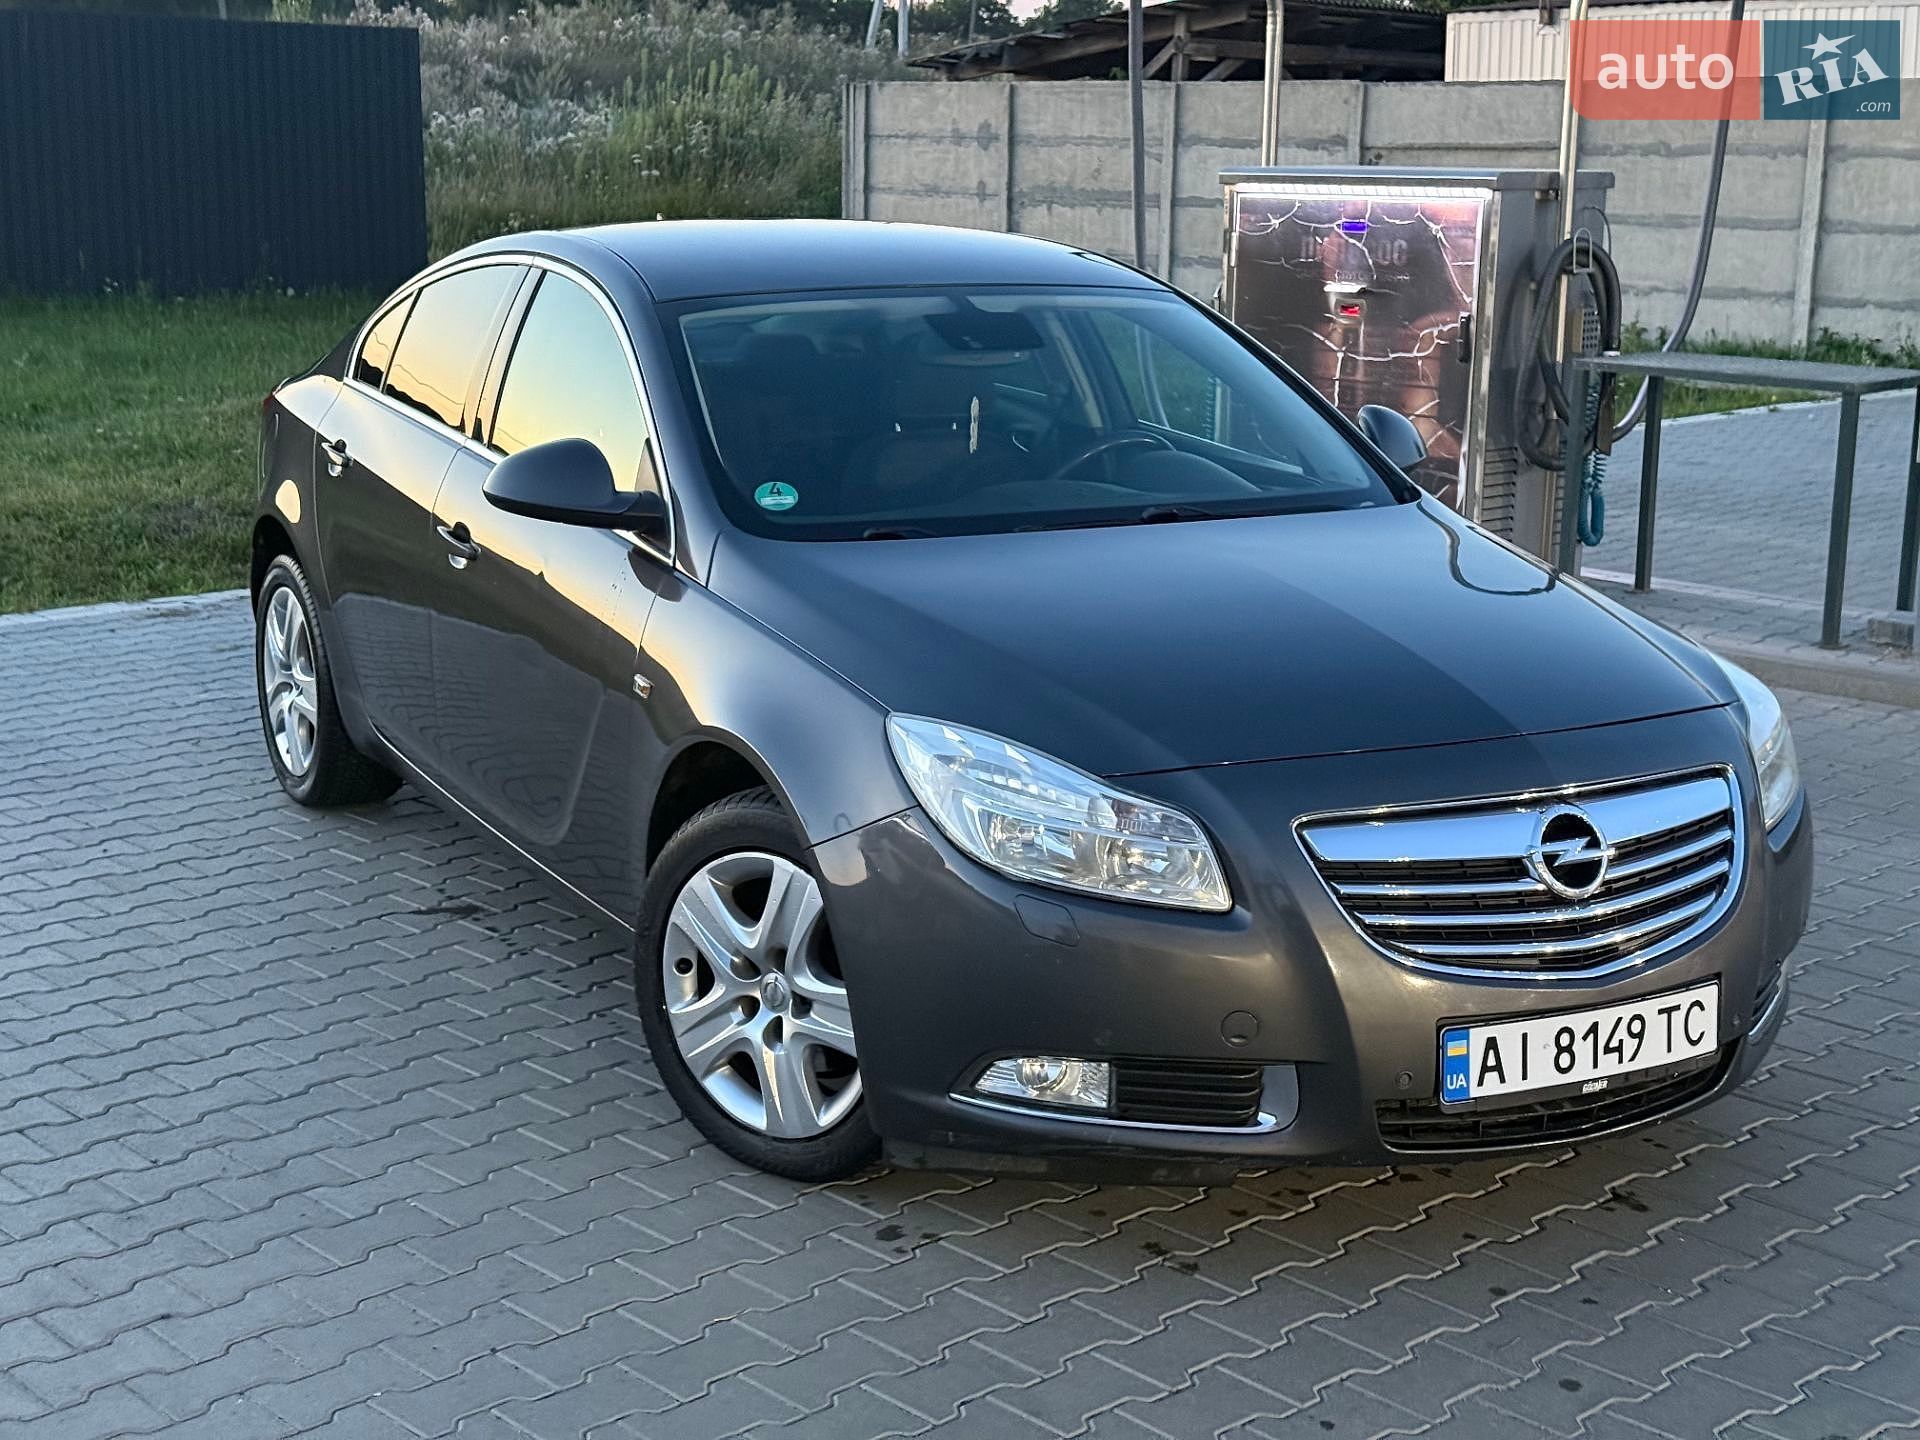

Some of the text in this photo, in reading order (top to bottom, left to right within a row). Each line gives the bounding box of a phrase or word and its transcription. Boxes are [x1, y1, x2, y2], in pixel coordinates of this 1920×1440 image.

[769, 482, 784, 497] 4
[1477, 999, 1706, 1087] AI 8149 TC
[1447, 1073, 1467, 1090] UA
